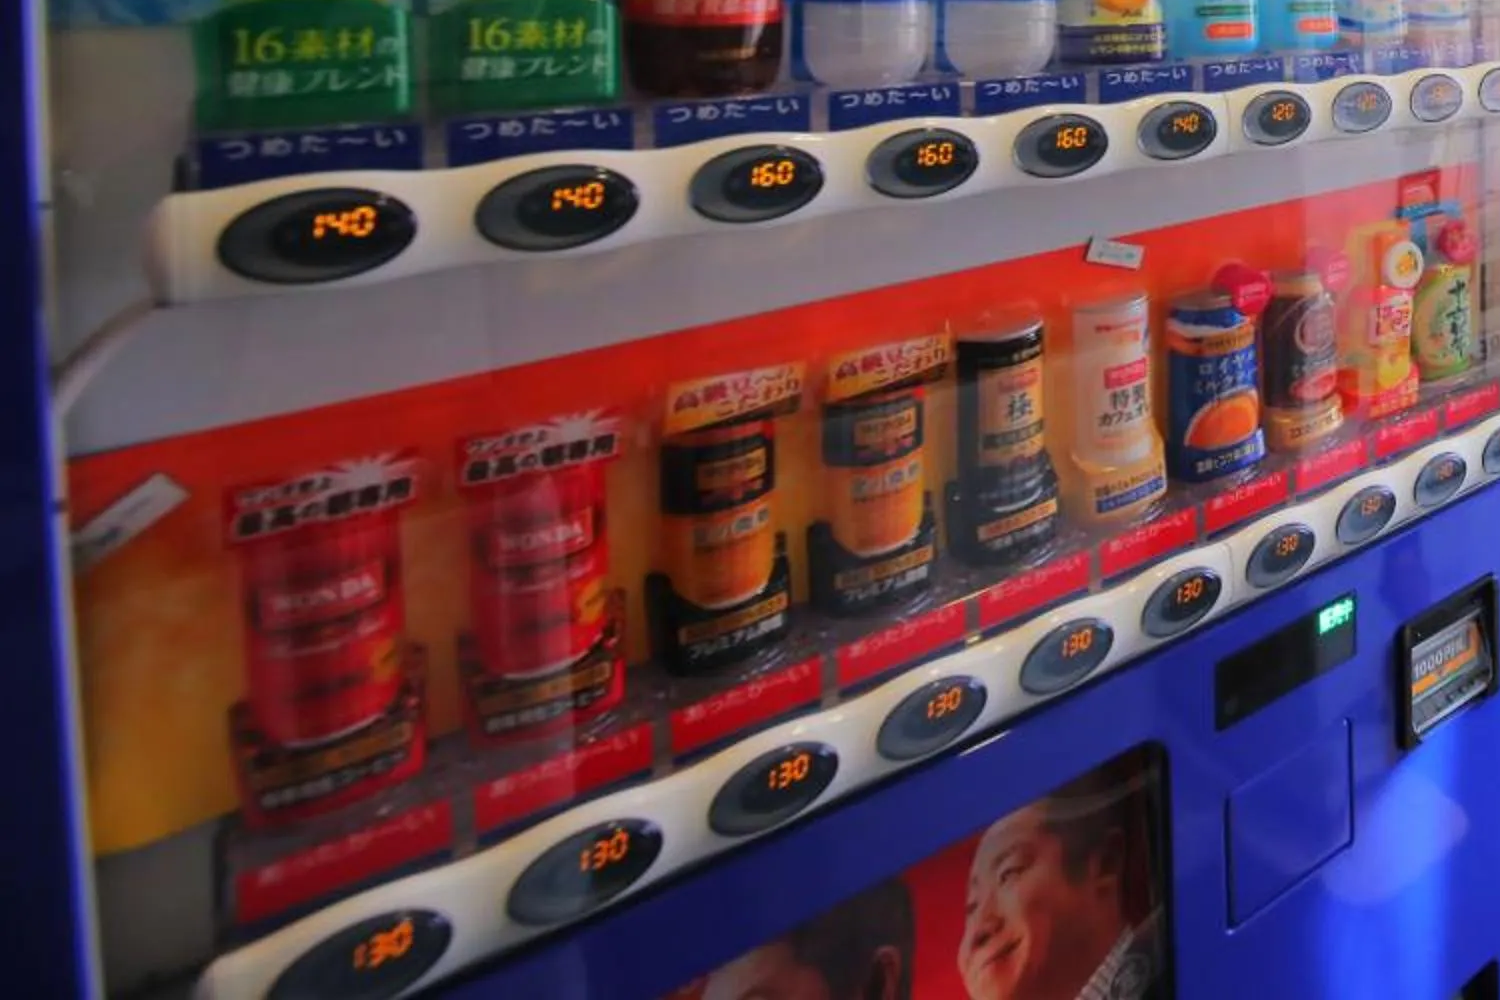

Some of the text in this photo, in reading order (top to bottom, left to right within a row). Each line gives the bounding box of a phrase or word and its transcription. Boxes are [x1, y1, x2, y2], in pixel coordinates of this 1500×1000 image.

[1055, 127, 1088, 149] 160
[917, 142, 954, 166] 160
[750, 160, 795, 187] 160
[551, 182, 604, 210] 140
[312, 205, 377, 238] 140
[1177, 579, 1203, 603] 130
[1063, 629, 1093, 655] 130
[927, 686, 963, 718] 130
[769, 753, 811, 788] 130
[580, 829, 629, 871] 130
[354, 919, 413, 968] 130
